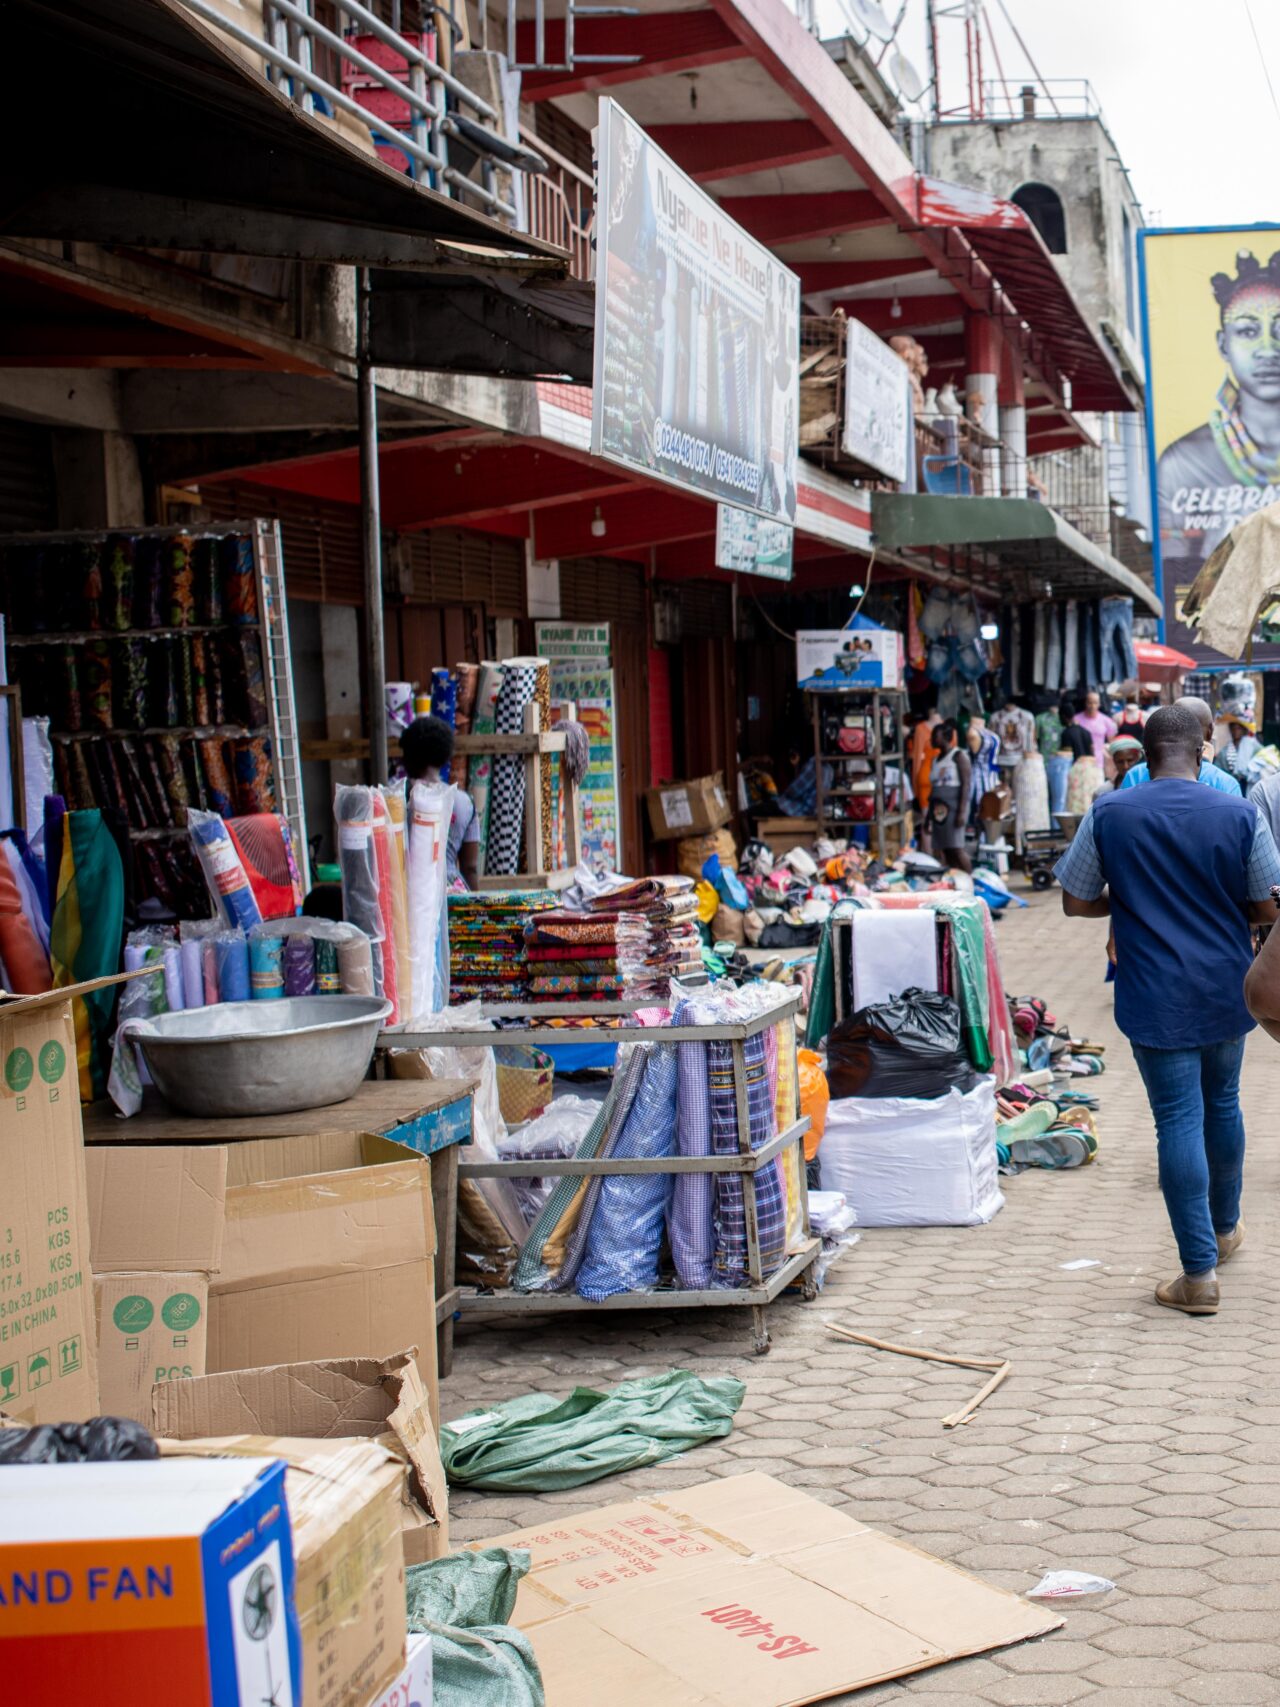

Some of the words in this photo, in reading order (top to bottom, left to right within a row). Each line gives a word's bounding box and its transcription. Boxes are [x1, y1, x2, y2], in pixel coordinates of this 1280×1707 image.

[713, 221, 731, 267] Ne
[735, 241, 766, 296] Hene
[1184, 515, 1221, 531] YOUR
[6, 1228, 12, 1243] 3
[47, 1206, 69, 1226] PCS
[48, 1229, 71, 1250] KGS
[50, 1252, 72, 1273] KGS
[11, 1319, 21, 1338] IN
[24, 1304, 57, 1332] CHINA
[87, 1564, 173, 1602] FAN
[700, 1603, 820, 1660] AS-4401
